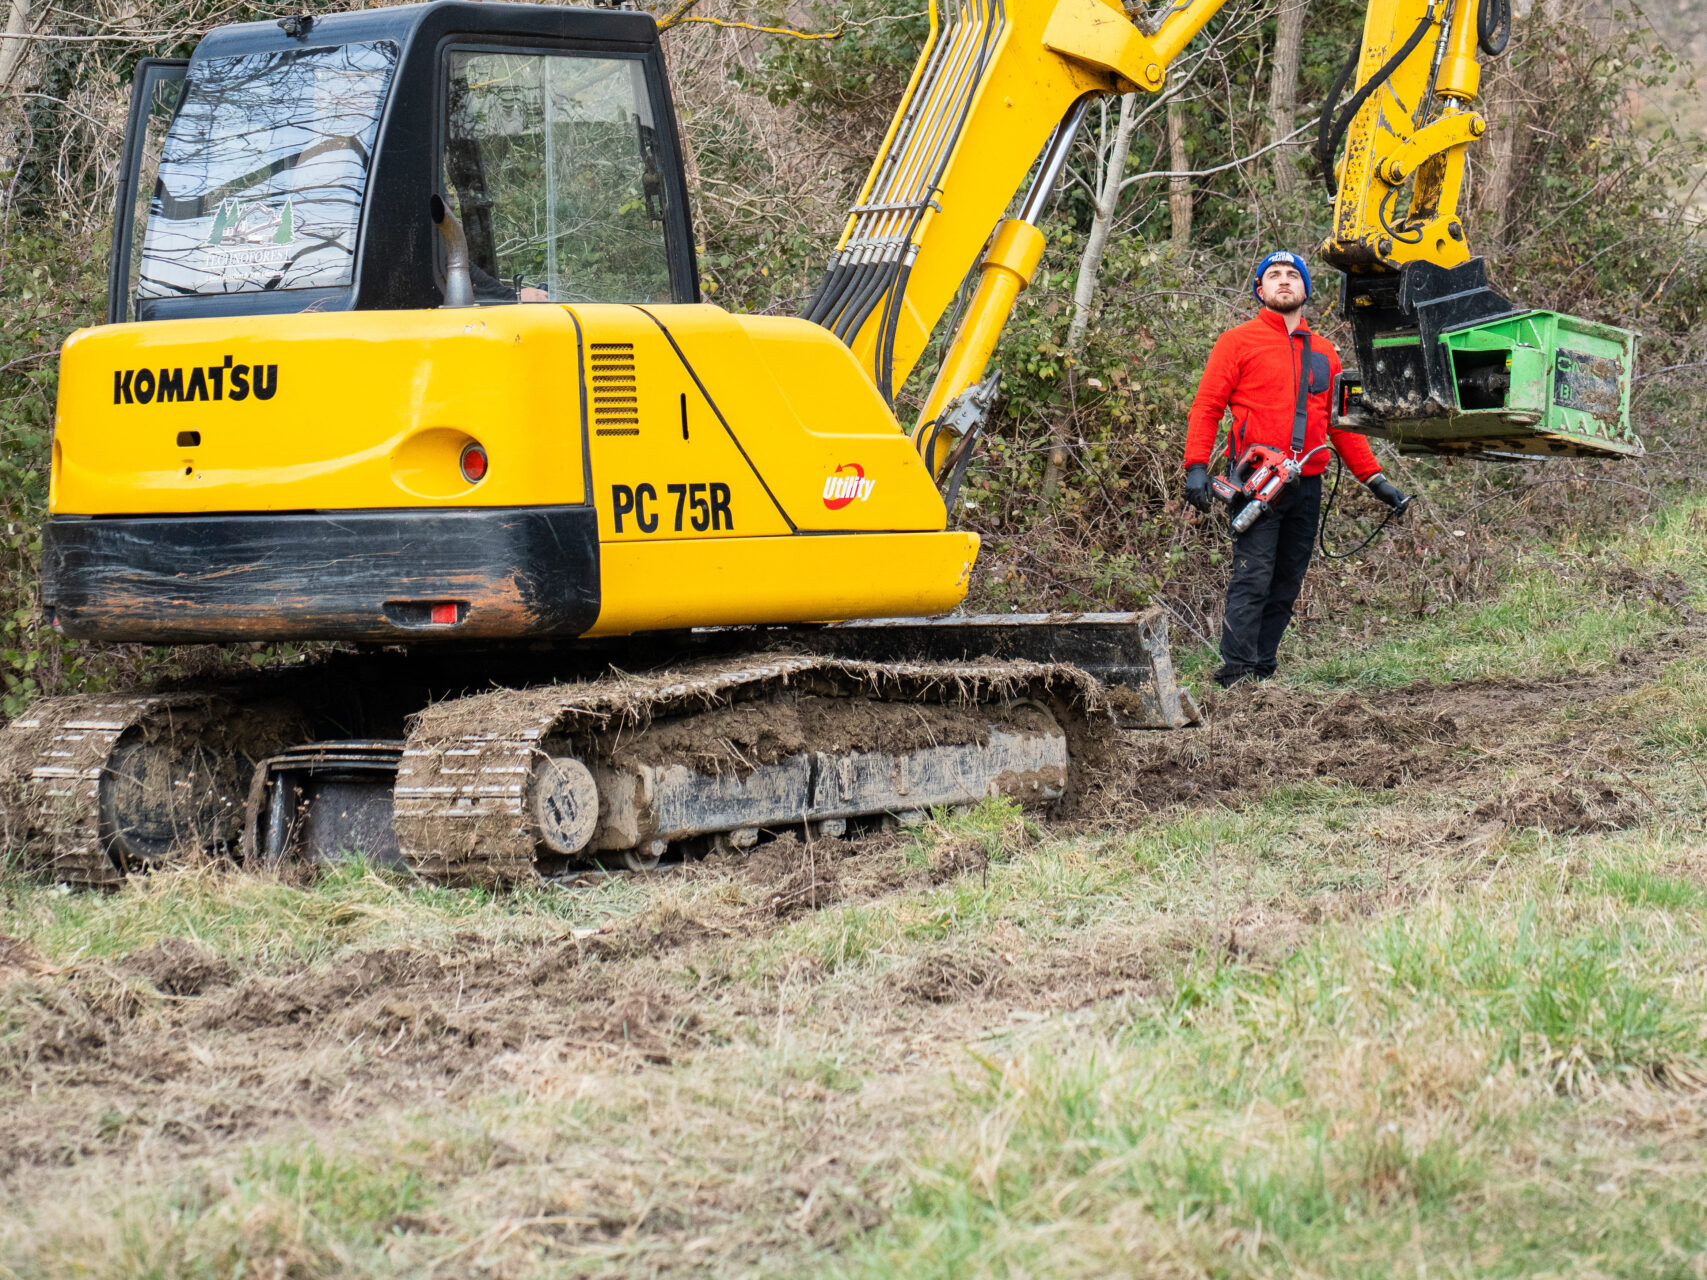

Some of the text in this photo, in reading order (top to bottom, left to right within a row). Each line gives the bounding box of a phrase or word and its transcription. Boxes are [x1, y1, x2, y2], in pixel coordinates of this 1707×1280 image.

[113, 355, 279, 405] KOMATSU
[611, 482, 735, 534] PC 75R
[822, 476, 876, 502] Utility
